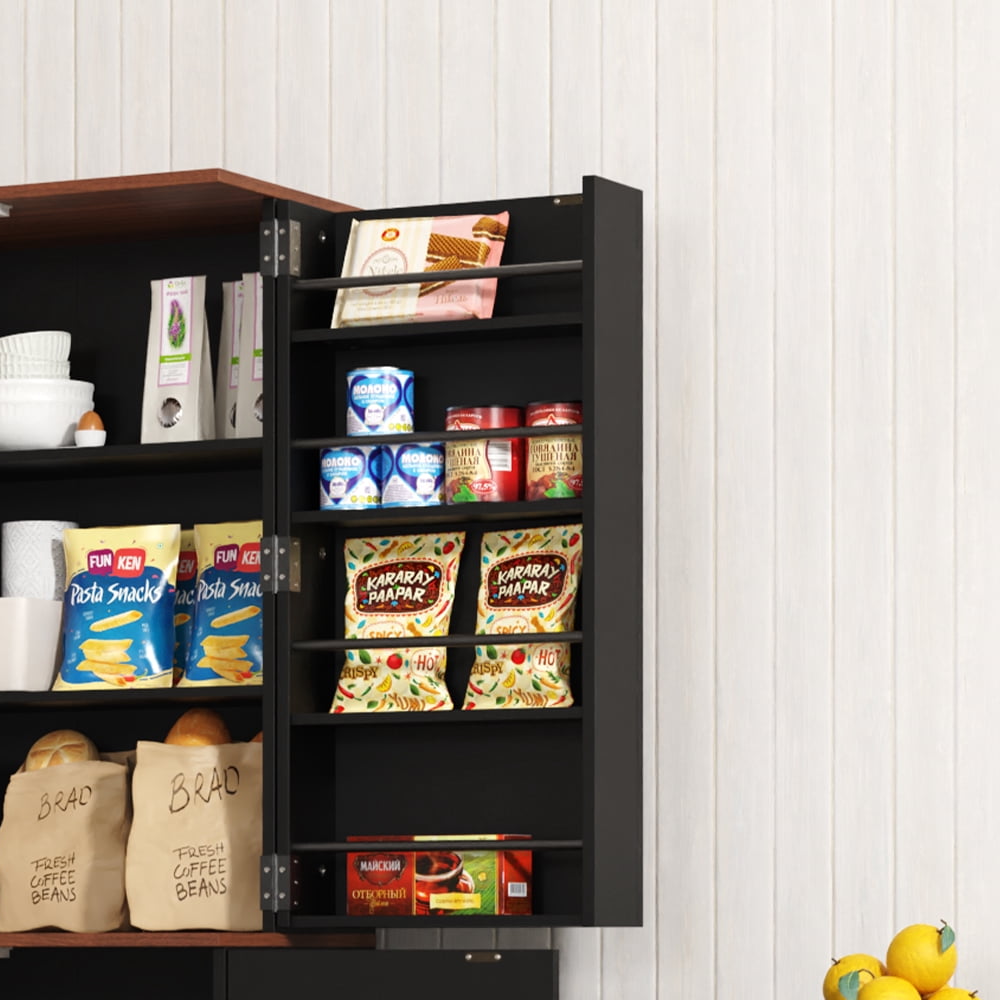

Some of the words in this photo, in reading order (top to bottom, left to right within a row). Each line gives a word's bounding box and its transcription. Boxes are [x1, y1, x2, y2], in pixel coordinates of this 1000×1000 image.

[353, 384, 397, 395] МОЛОКО
[321, 456, 359, 467] МОЛОКО
[402, 452, 444, 464] МОЛОКО
[89, 554, 112, 569] FUN
[117, 554, 142, 571] KEN
[178, 558, 195, 573] EN
[216, 549, 237, 564] FUN
[366, 570, 436, 591] KARARAY
[497, 564, 560, 585] KARARAY
[70, 581, 103, 606] Pasta
[107, 579, 162, 605] Snacks
[197, 579, 226, 602] Pasta
[228, 578, 263, 601] Snac
[368, 587, 426, 605] PAAPAR
[498, 580, 551, 600] PAAPAR
[416, 655, 440, 672] HOT
[538, 648, 561, 667] HOT
[472, 662, 504, 679] RISPY
[169, 766, 240, 814] BRAD
[37, 785, 92, 821] BRAD
[172, 842, 225, 860] FRESH
[30, 852, 76, 872] FRESH
[174, 858, 227, 879] COFFEE
[360, 860, 401, 872] МАЙСКИЙ
[30, 870, 76, 889] COFFEE
[32, 887, 77, 905] BEANS
[175, 878, 228, 902] BEANS
[352, 888, 406, 899] ОТБОРНЫЙ
